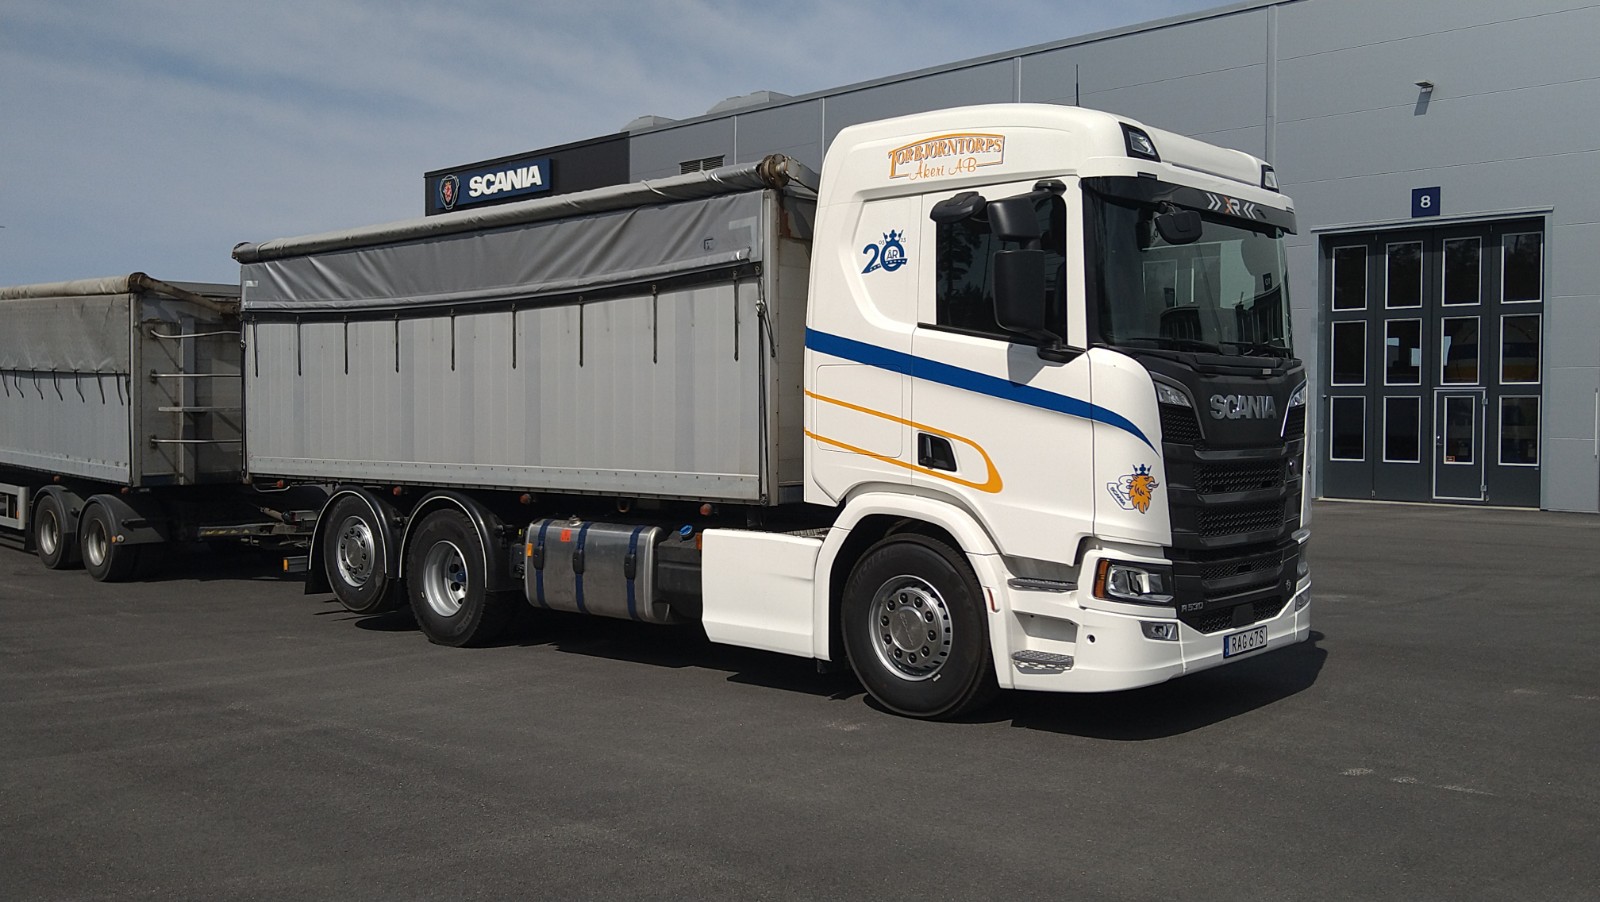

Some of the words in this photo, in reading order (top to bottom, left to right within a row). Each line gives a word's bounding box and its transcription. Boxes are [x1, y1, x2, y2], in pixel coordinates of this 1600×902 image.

[948, 157, 977, 175] AB
[468, 165, 542, 197] SCANIA
[1420, 195, 1431, 208] 8
[1209, 394, 1277, 420] SCANIA
[1232, 634, 1247, 653] RAG
